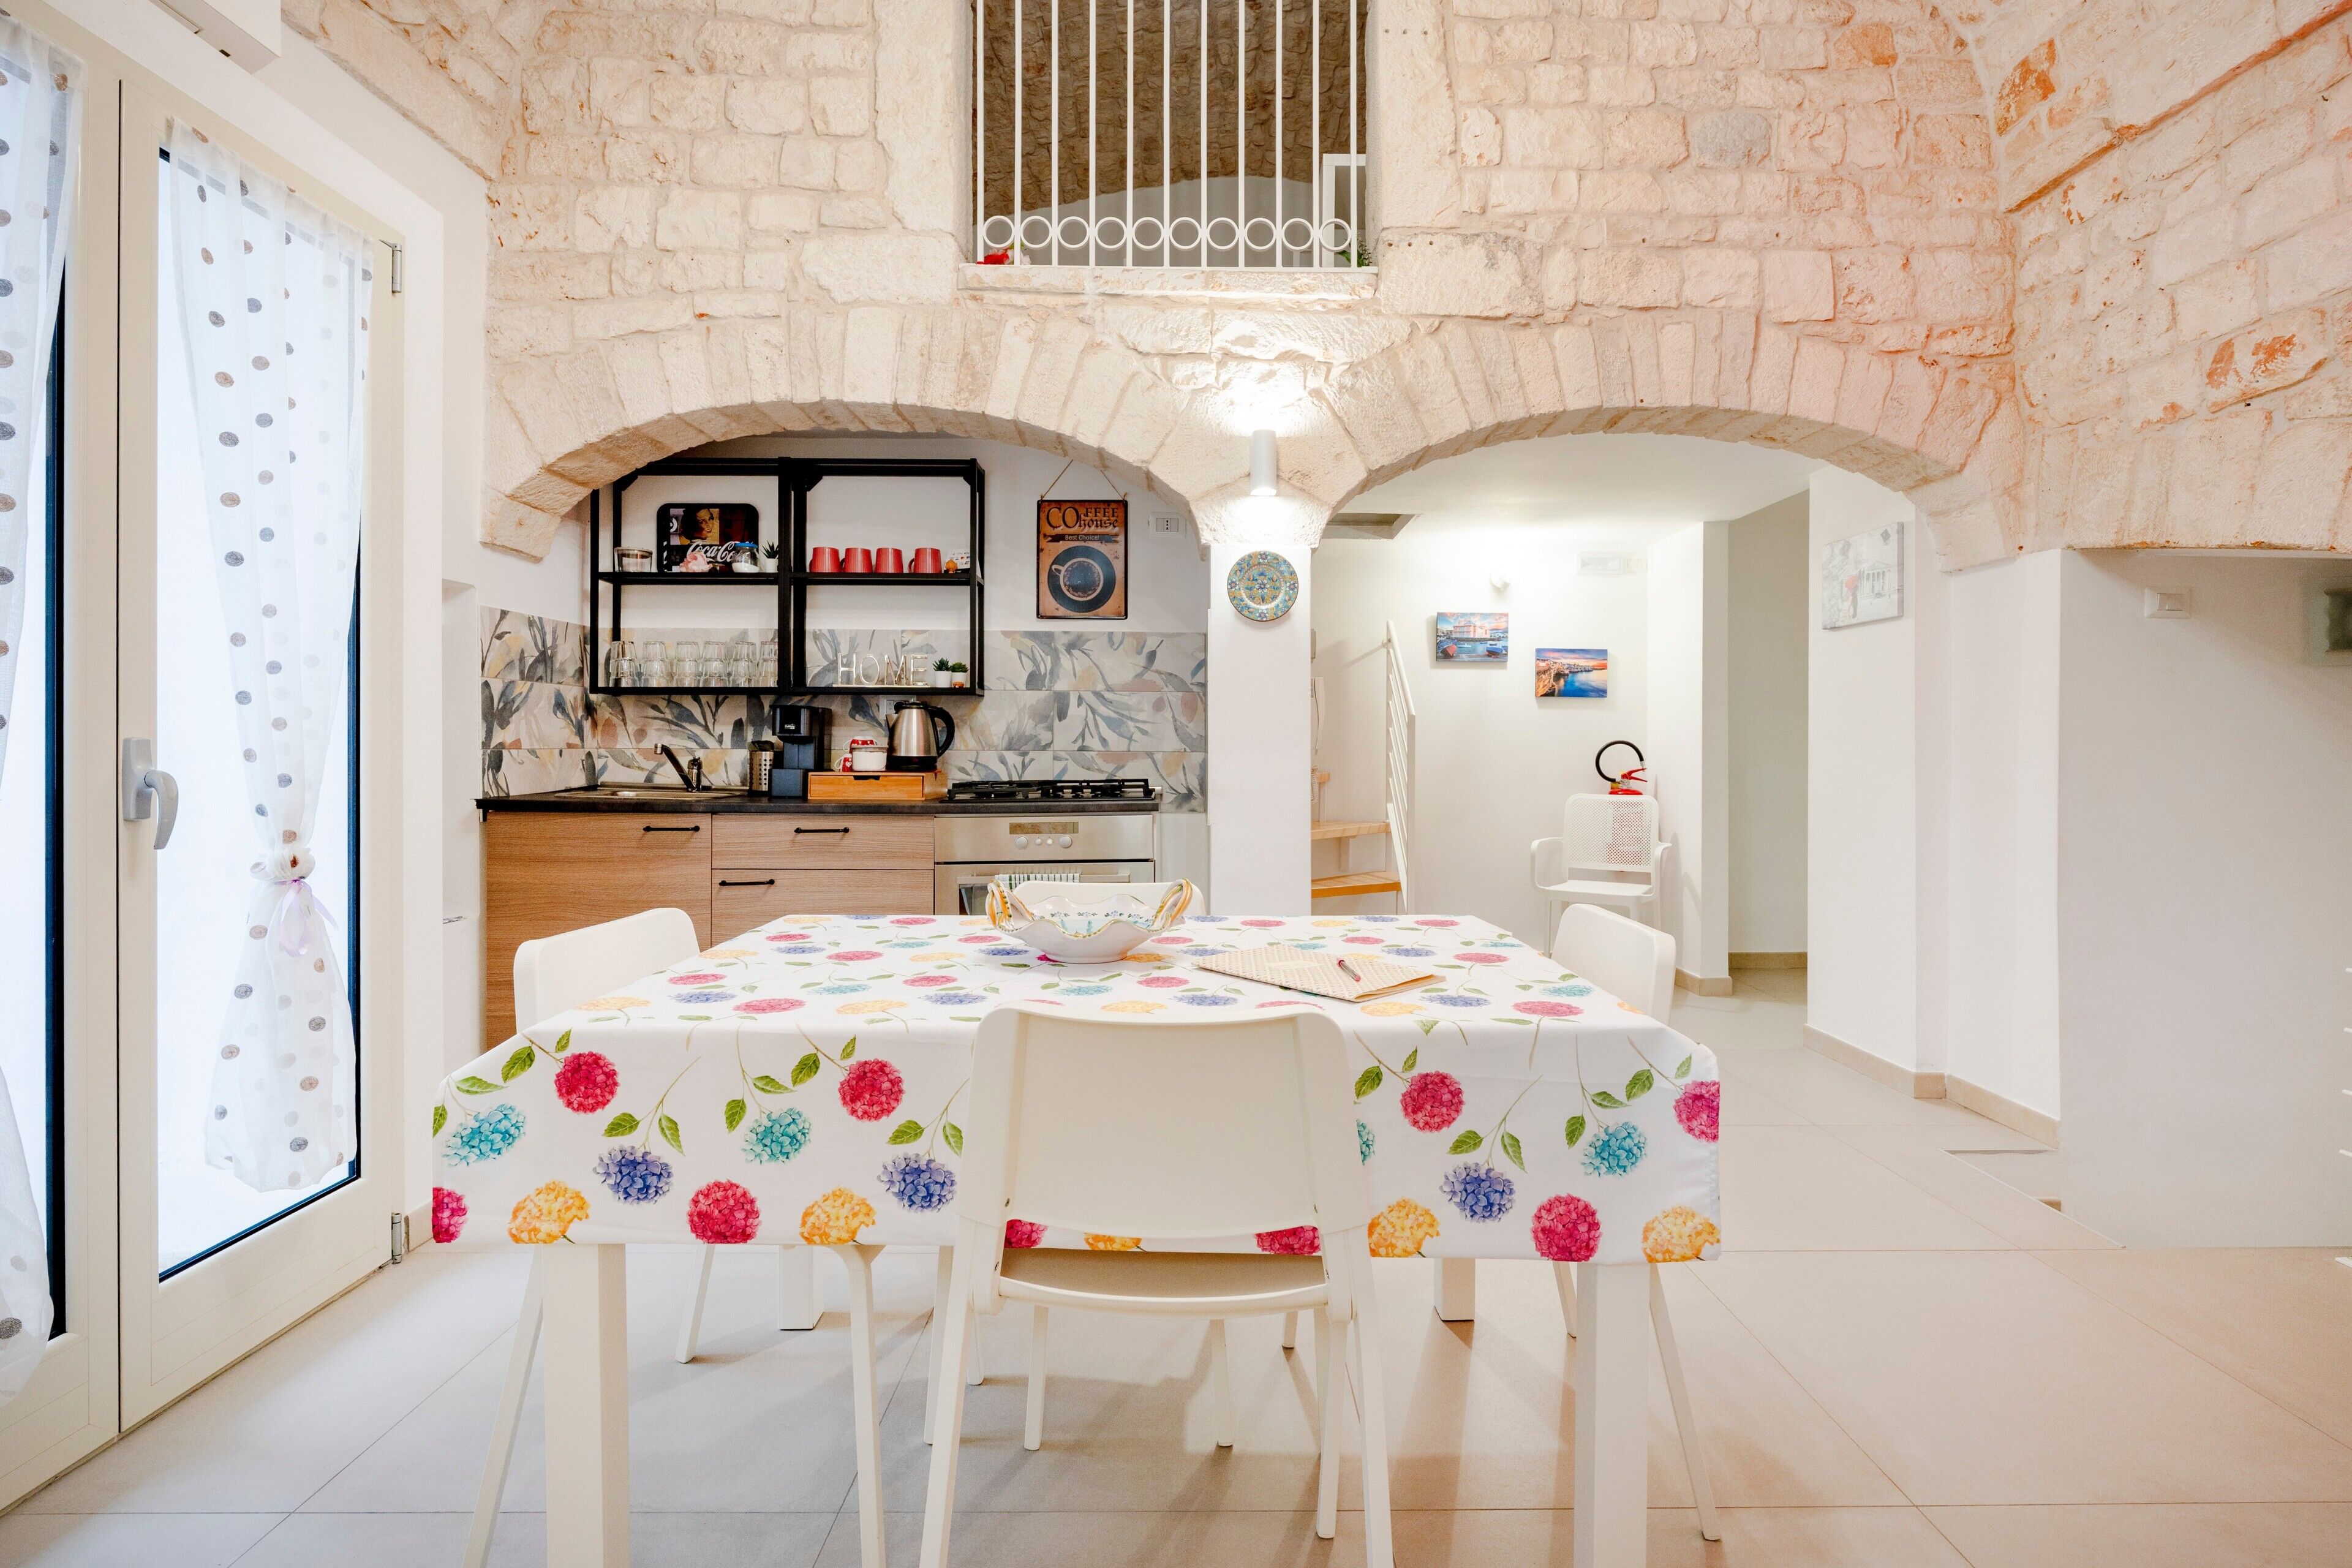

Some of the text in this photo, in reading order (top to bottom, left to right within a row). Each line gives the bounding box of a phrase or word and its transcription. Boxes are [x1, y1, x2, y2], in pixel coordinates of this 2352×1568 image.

[1047, 507, 1118, 529] COFFEE
[1079, 513, 1118, 533] house
[838, 654, 927, 685] HOME
